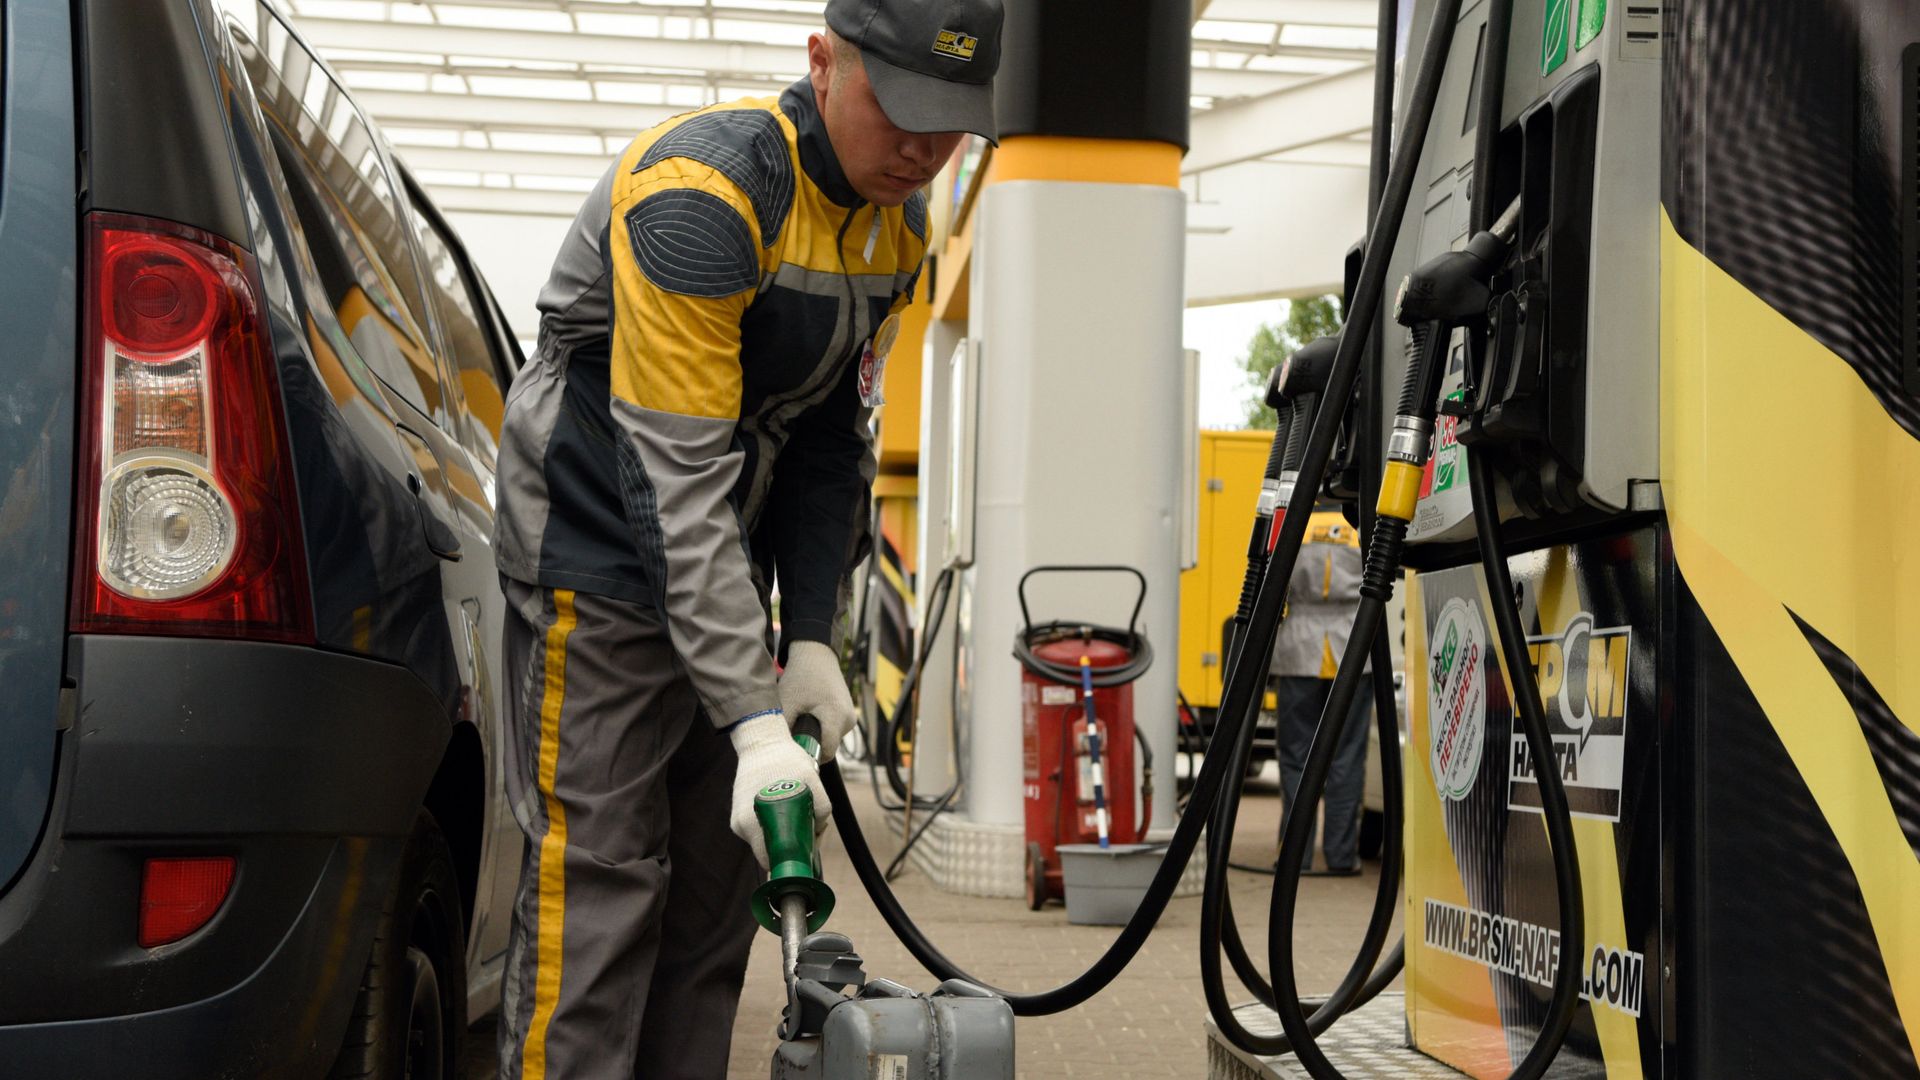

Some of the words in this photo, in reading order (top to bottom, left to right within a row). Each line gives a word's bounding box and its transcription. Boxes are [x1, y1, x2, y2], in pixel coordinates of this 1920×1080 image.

[1440, 643, 1478, 776] ПЕРЕВІРЕНО
[1513, 741, 1577, 781] НАТА
[1425, 899, 1642, 1016] WWW.BRSM-NAF.COM
